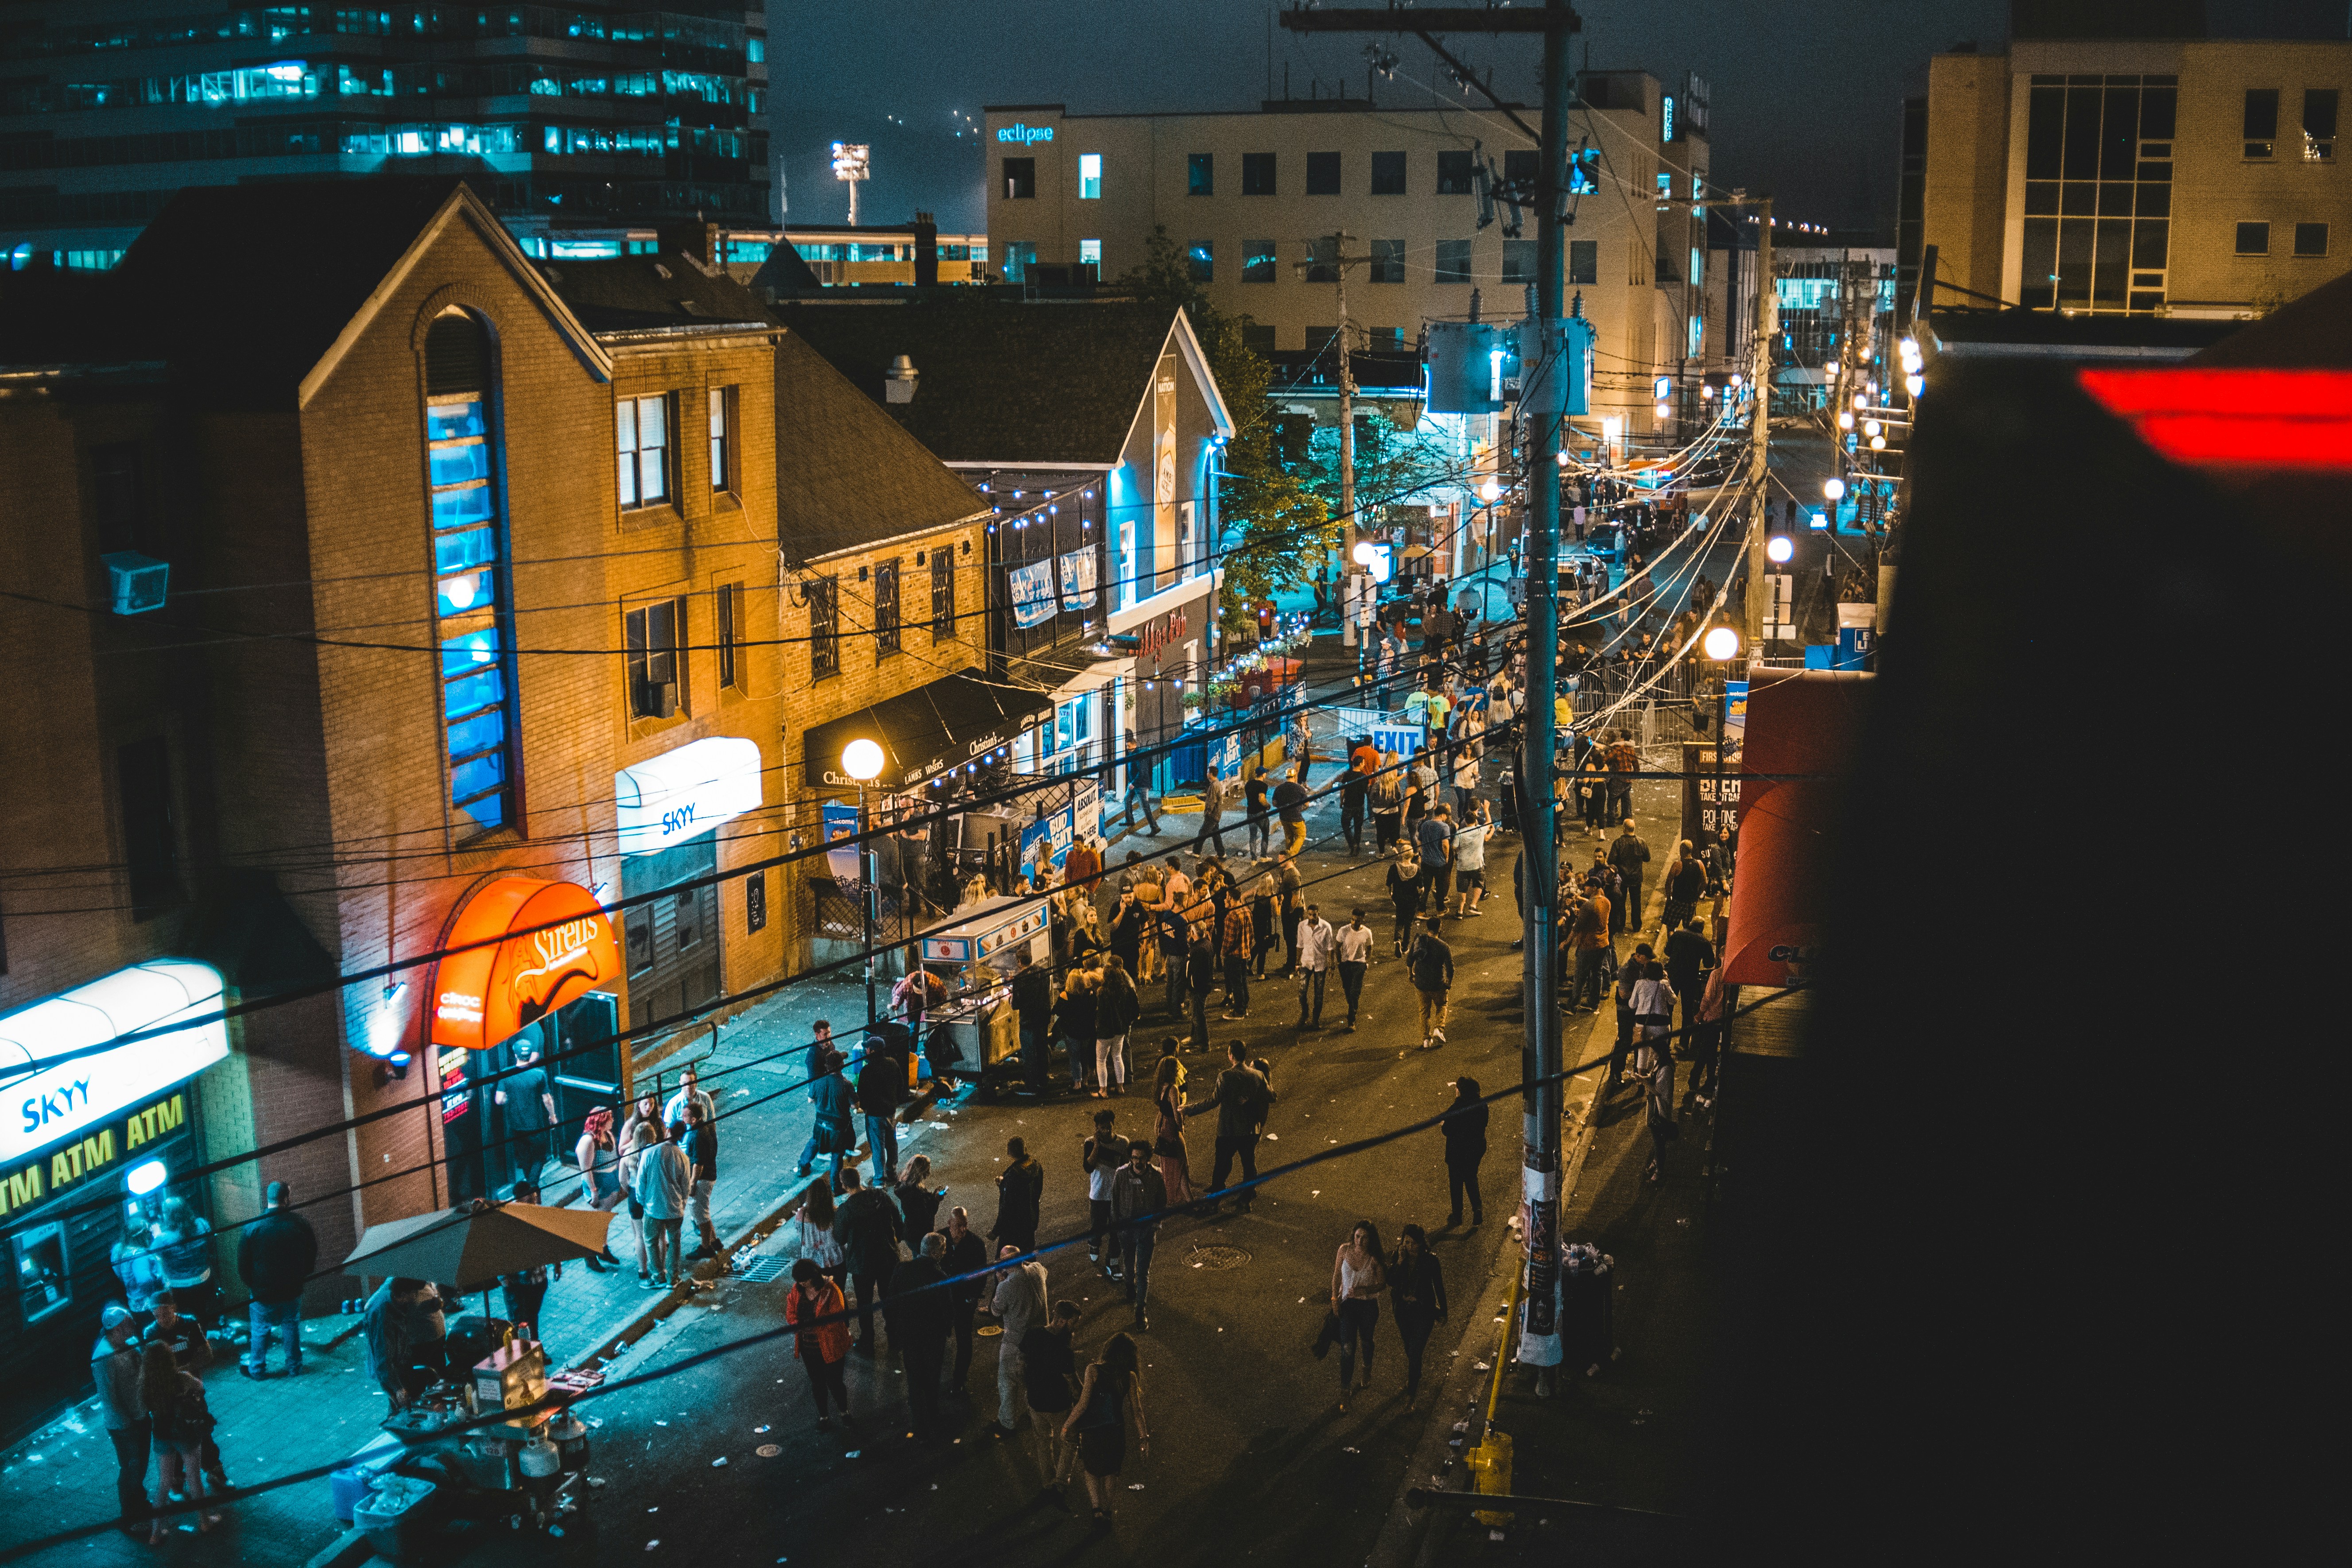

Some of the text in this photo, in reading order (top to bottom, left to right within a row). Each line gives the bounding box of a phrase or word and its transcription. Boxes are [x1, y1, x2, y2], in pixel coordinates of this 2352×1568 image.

[996, 123, 1054, 146] eclipse
[1158, 382, 1174, 393] NATION
[970, 732, 997, 756] Christian's
[1020, 714, 1036, 729] JAMESON
[1037, 708, 1052, 722] ABSOLUT
[1374, 731, 1418, 755] EXIT
[1702, 752, 1717, 762] FIRS
[663, 802, 695, 835] SKYY
[1050, 812, 1068, 837] BUD
[1087, 824, 1097, 840] HERE
[515, 917, 598, 991] Sirens
[22, 1073, 92, 1133] SKYY
[0, 1095, 183, 1216] TM ATM ATM
